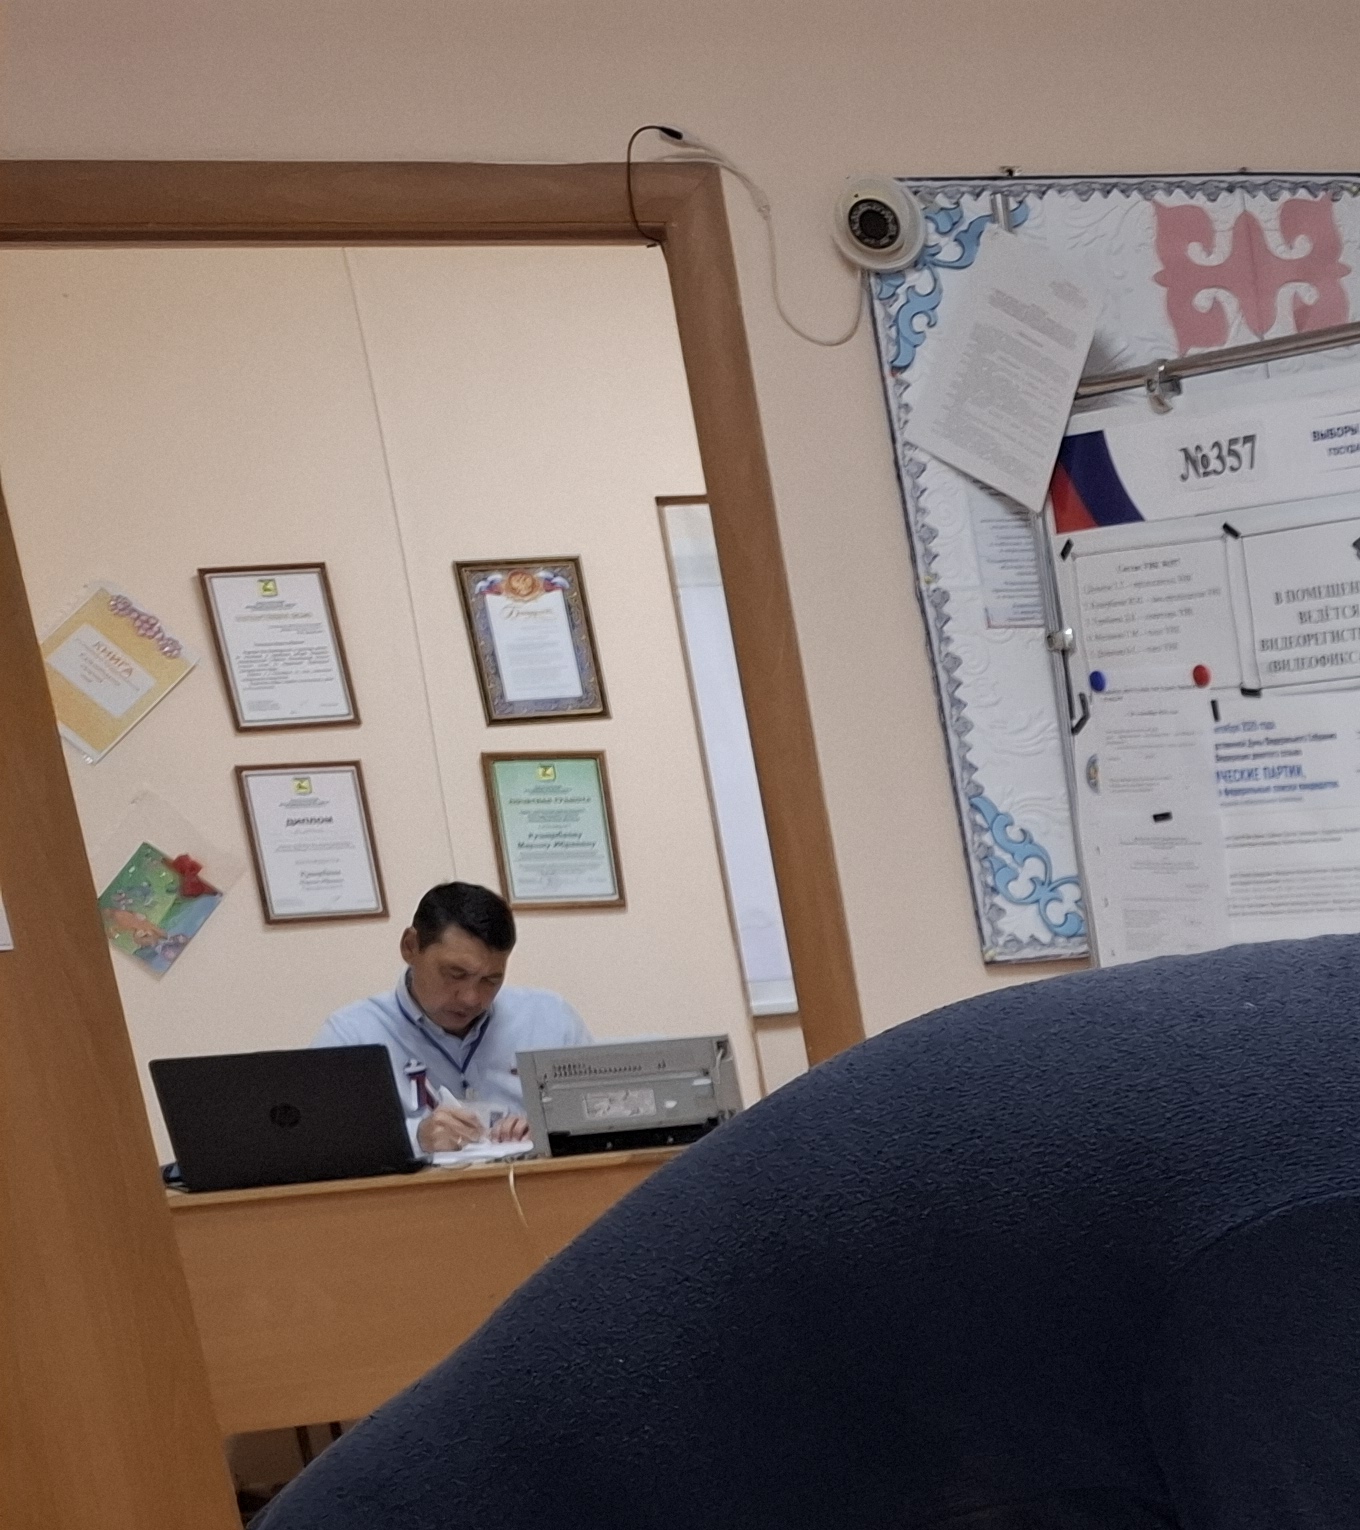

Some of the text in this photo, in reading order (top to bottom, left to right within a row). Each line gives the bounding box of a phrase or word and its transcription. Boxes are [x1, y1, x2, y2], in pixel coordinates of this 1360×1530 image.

[1312, 425, 1359, 442] ВЫБОРЫ
[1179, 434, 1257, 483] №357
[1274, 591, 1283, 605] В
